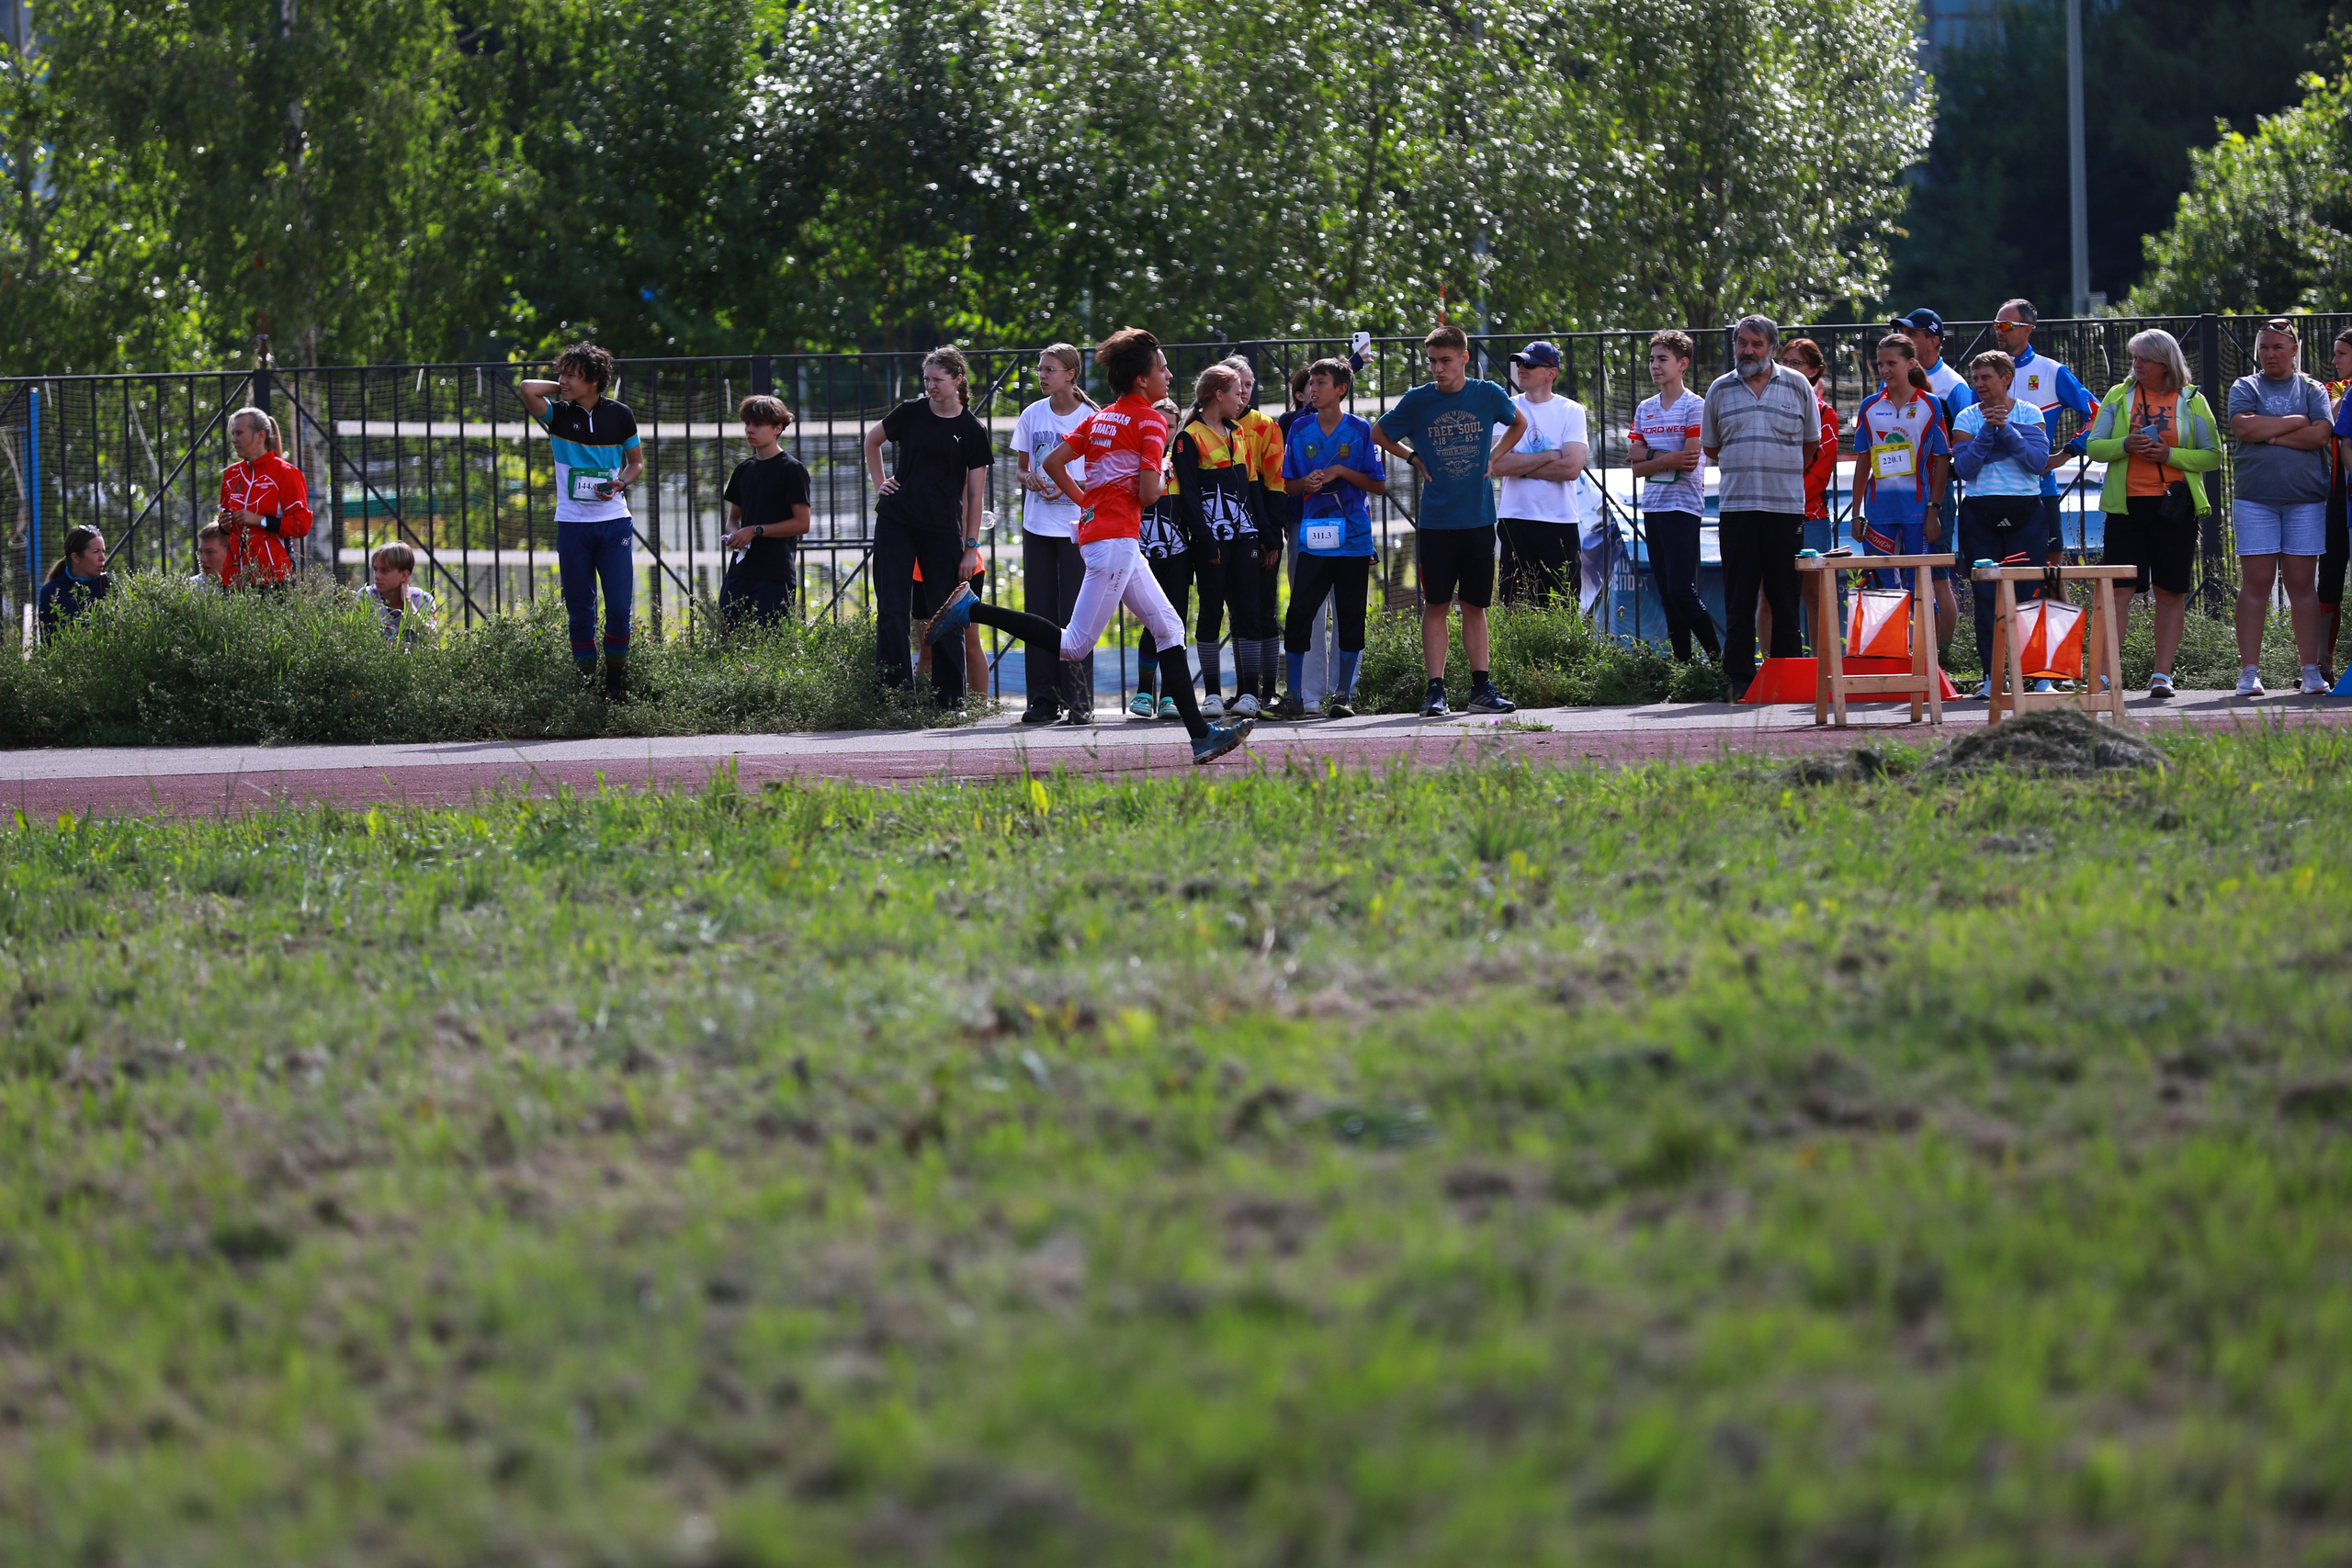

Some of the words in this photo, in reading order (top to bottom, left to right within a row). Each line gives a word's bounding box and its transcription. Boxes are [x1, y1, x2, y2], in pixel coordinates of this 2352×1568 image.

[1428, 425, 1453, 437] FREE
[1458, 422, 1484, 434] SOUL
[1667, 425, 1686, 434] WES
[1439, 437, 1446, 446] 18
[1464, 434, 1474, 442] 65
[1883, 455, 1902, 465] 220.1
[578, 481, 597, 490] 144.
[1866, 530, 1893, 550] ОРОНЕЖ
